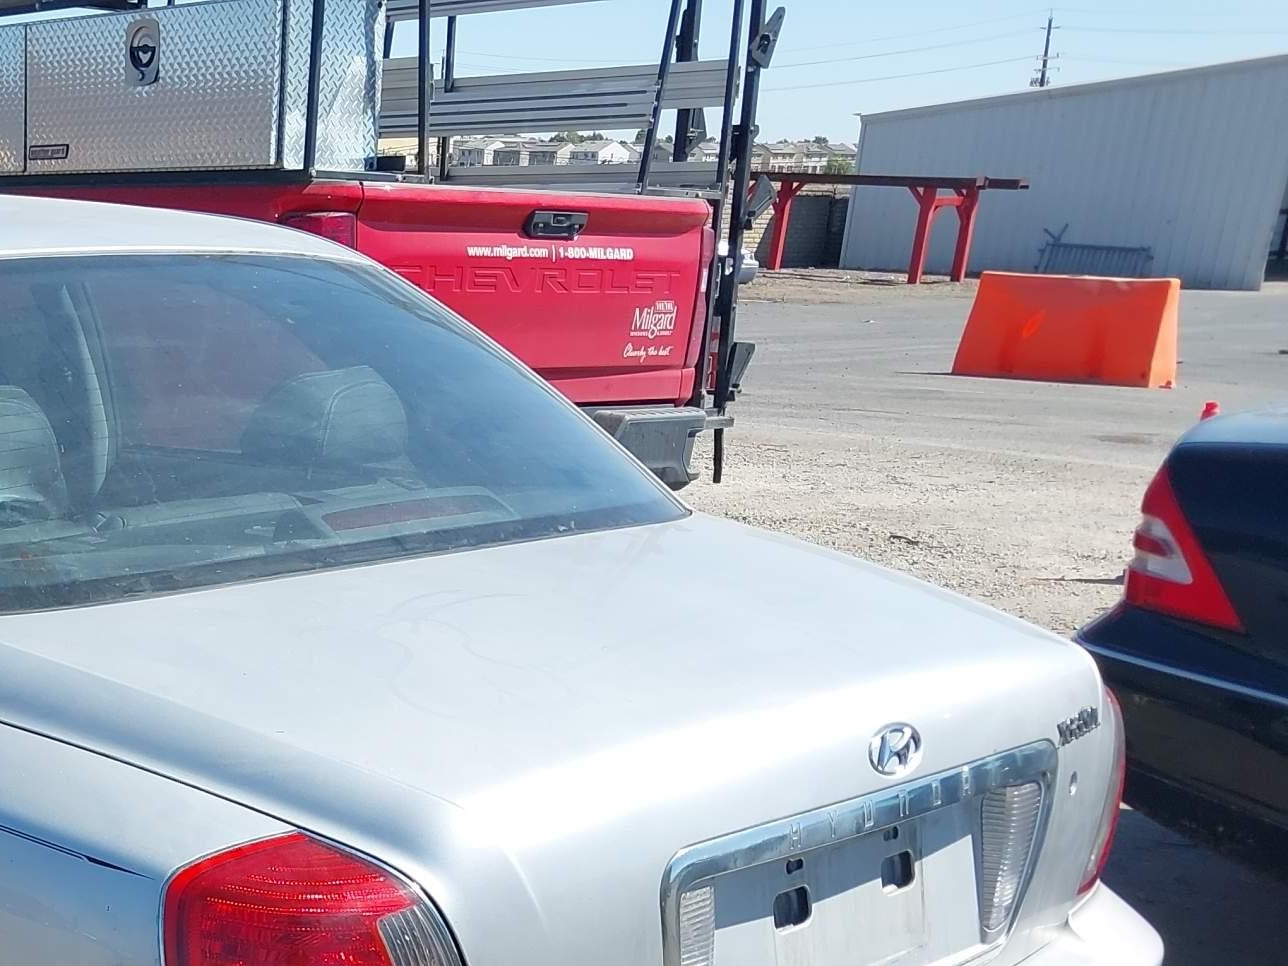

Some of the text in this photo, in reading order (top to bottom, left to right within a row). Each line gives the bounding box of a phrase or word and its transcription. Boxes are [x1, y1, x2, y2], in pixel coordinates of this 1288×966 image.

[467, 245, 549, 260] www.milgard.com
[559, 247, 634, 260] 1-800-MILGARD
[629, 305, 678, 339] Milgard
[789, 758, 1000, 850] HYUNDAI
